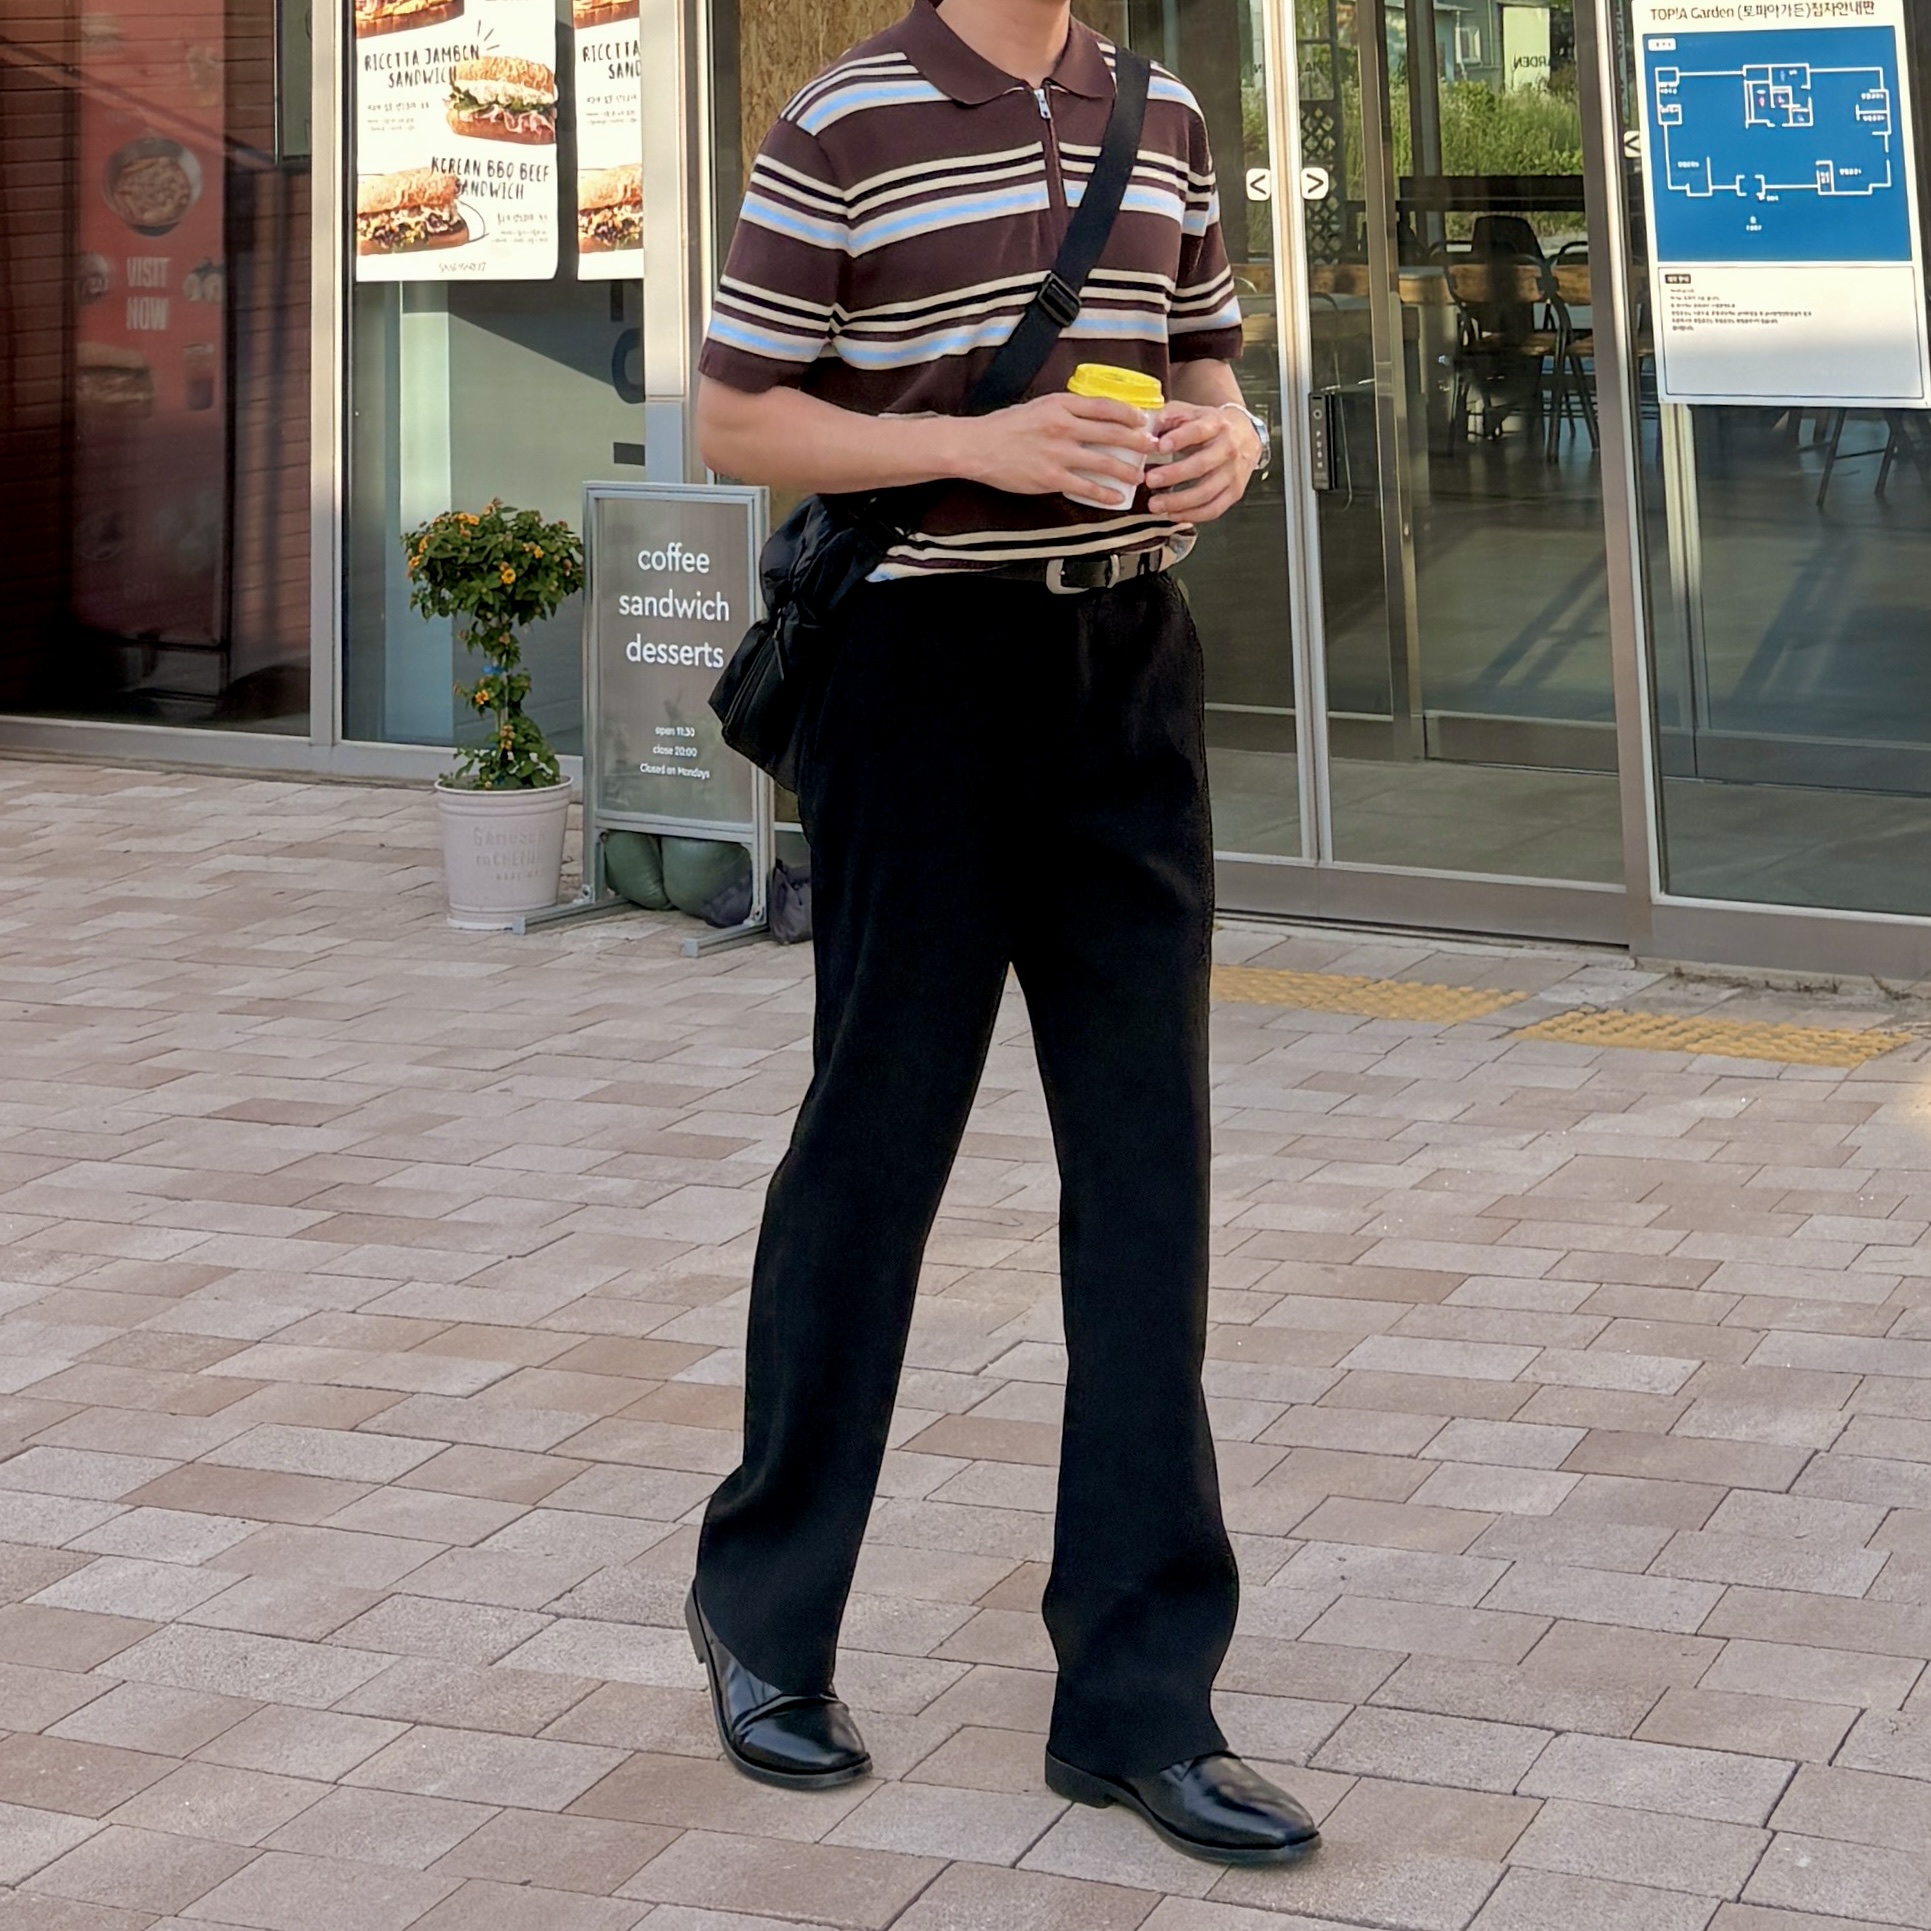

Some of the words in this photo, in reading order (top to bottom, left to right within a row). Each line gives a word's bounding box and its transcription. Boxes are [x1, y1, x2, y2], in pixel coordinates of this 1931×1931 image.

[1691, 5, 1734, 19] Garden
[388, 65, 457, 89] SANDWICH
[608, 60, 641, 79] SAND
[519, 162, 549, 183] BEEF
[126, 256, 171, 288] VISIT
[126, 297, 170, 330] NOW
[637, 541, 711, 574] coffee
[618, 587, 730, 622] sandwich
[625, 632, 725, 668] desserts
[655, 726, 676, 737] open
[652, 743, 674, 756] close
[640, 762, 666, 775] Closed
[666, 766, 676, 776] on
[677, 766, 711, 780] Mondays
